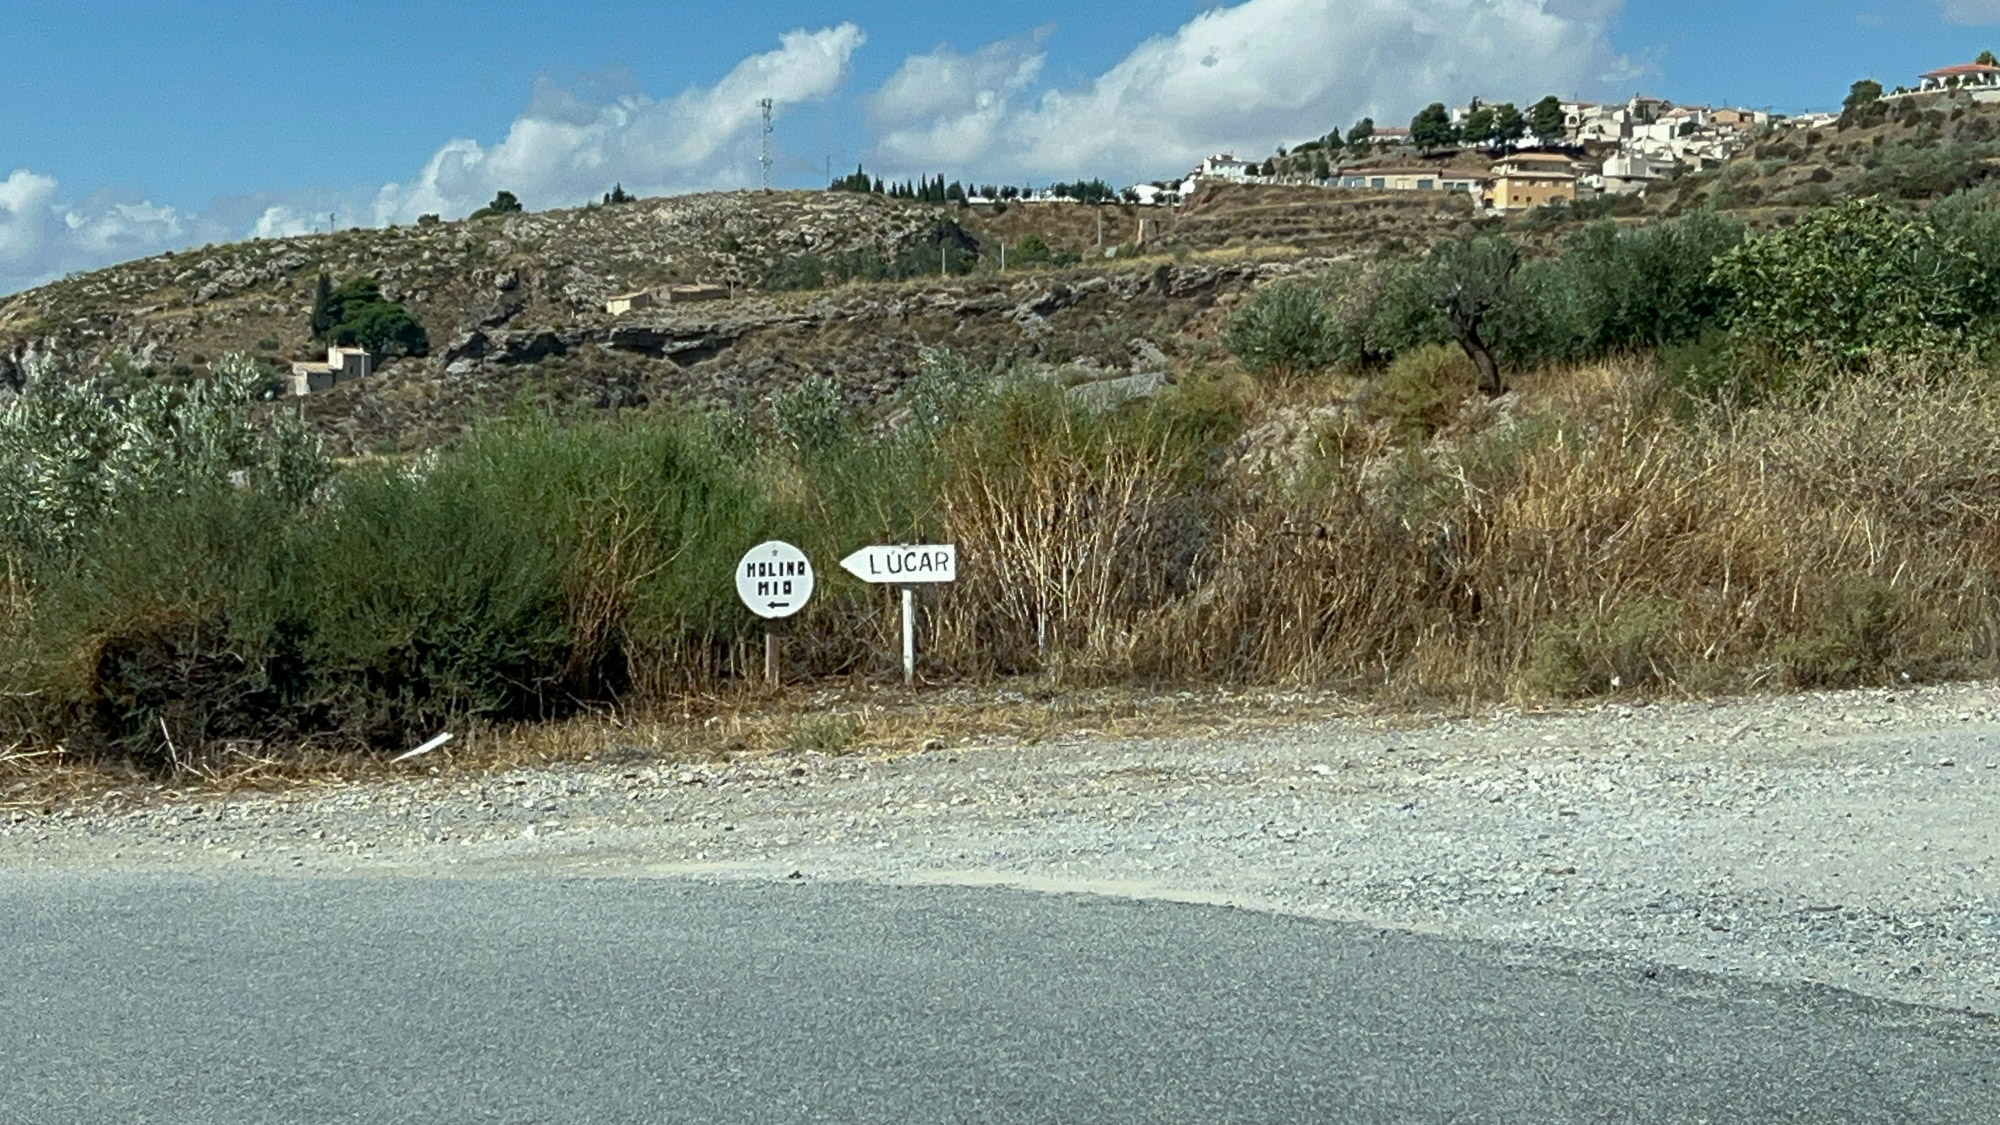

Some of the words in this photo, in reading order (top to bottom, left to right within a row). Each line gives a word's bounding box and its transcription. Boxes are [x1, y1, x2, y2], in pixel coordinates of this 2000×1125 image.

[746, 561, 806, 578] MOLINO
[869, 551, 949, 575] LÚCAR
[758, 580, 793, 596] MIO
